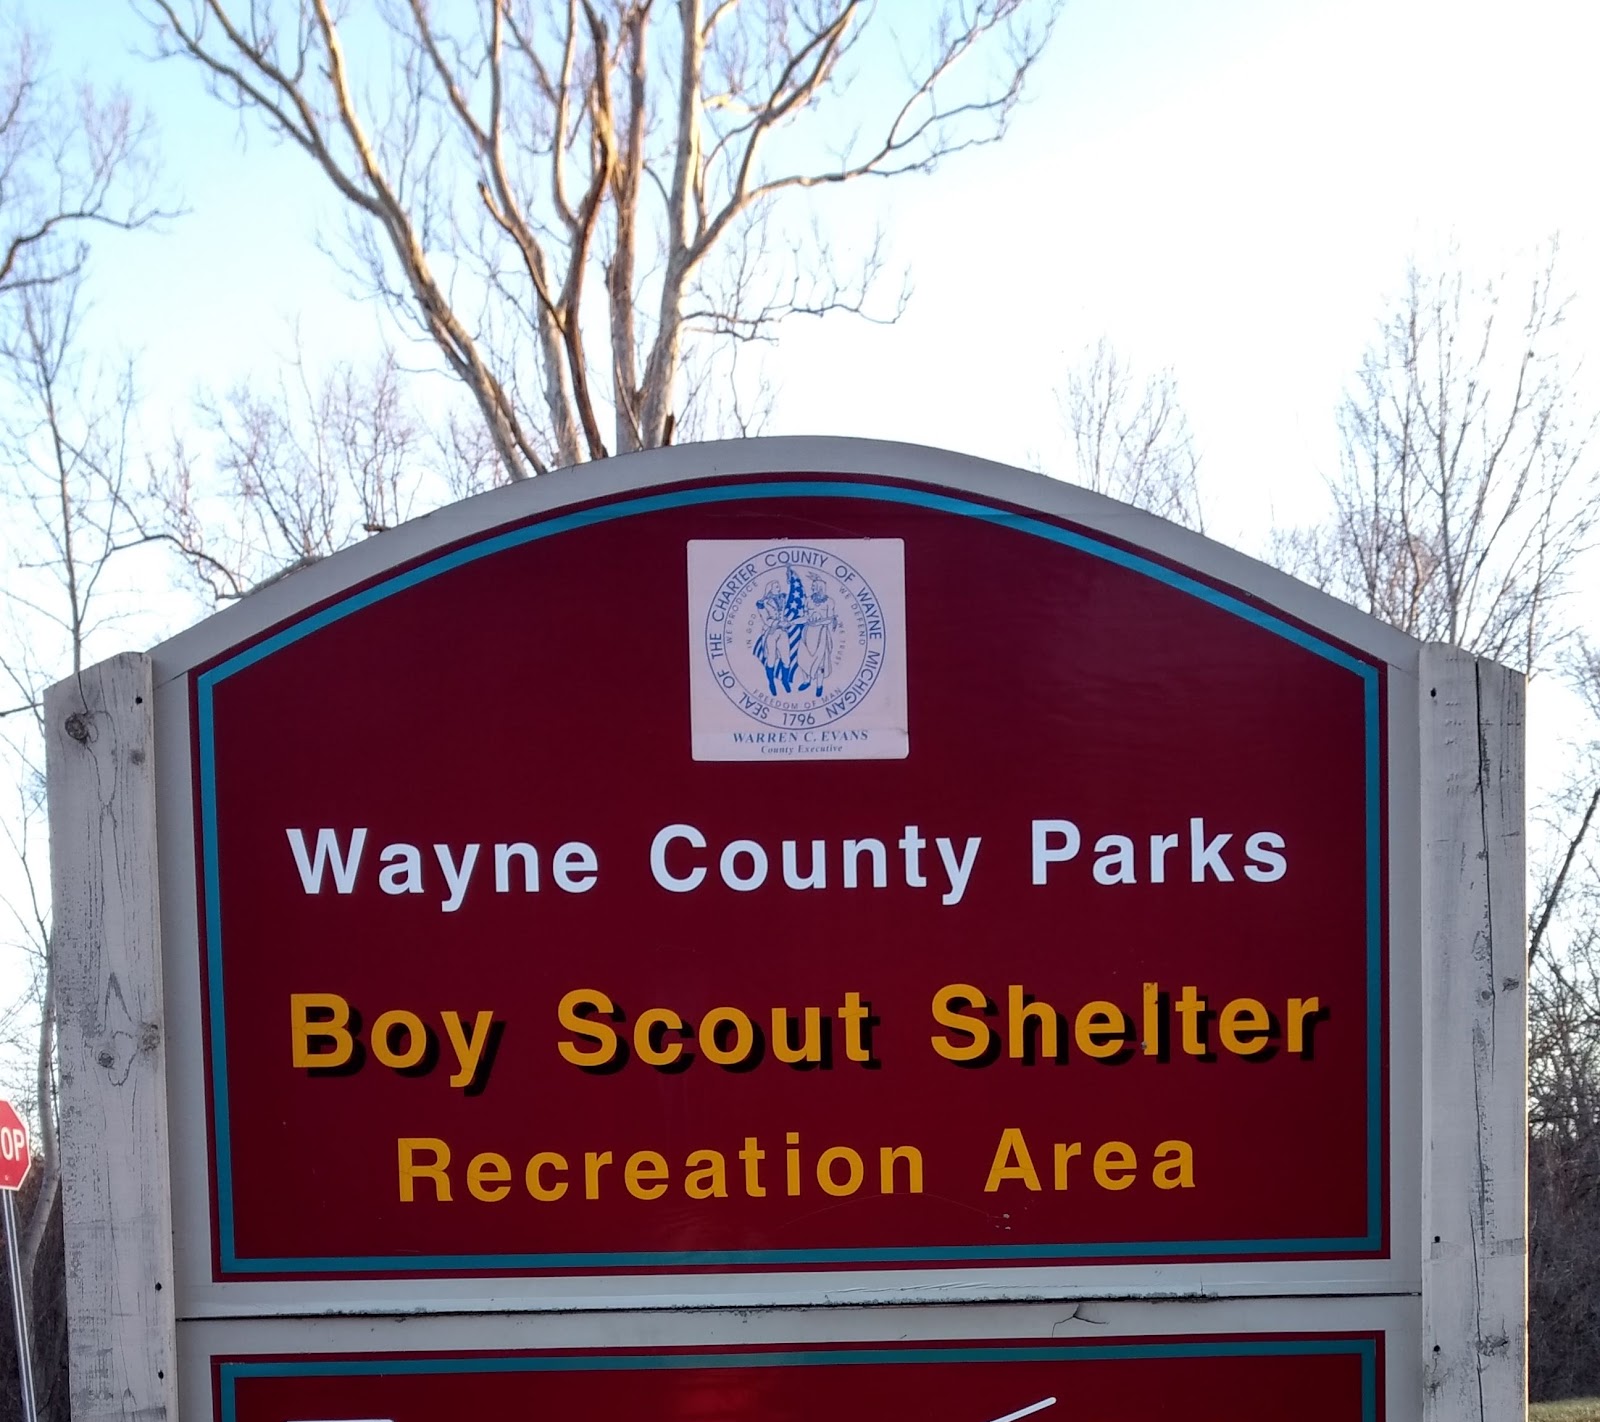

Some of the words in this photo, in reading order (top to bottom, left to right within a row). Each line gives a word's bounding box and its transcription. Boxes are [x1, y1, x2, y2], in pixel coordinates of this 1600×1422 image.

[764, 550, 829, 568] COUNTY
[834, 565, 856, 583] OF
[711, 563, 758, 622] CHARTER
[727, 580, 759, 625] PRODUCE
[850, 603, 866, 646] DEFEND
[856, 587, 882, 640] WAYNE
[709, 633, 724, 660] THE
[716, 669, 736, 689] OF
[825, 650, 881, 719] MICHIGAN
[738, 691, 770, 720] SEAL
[752, 688, 799, 710] FREEDOM
[804, 700, 817, 709] OF
[821, 687, 842, 703] MAN
[783, 712, 816, 727] 1796
[733, 732, 798, 743] WARREN
[804, 731, 817, 742] C.
[821, 730, 869, 742] EVANS
[760, 745, 794, 756] County
[797, 744, 843, 754] Executive
[286, 827, 600, 913] Wayne
[649, 823, 982, 906] County
[1031, 817, 1289, 886] Parks
[290, 992, 498, 1090] Boy
[557, 988, 872, 1067] Scout
[931, 982, 1321, 1063] Shelter
[0, 1126, 25, 1162] OP
[396, 1132, 925, 1203] Recreation
[983, 1127, 1196, 1193] Area
